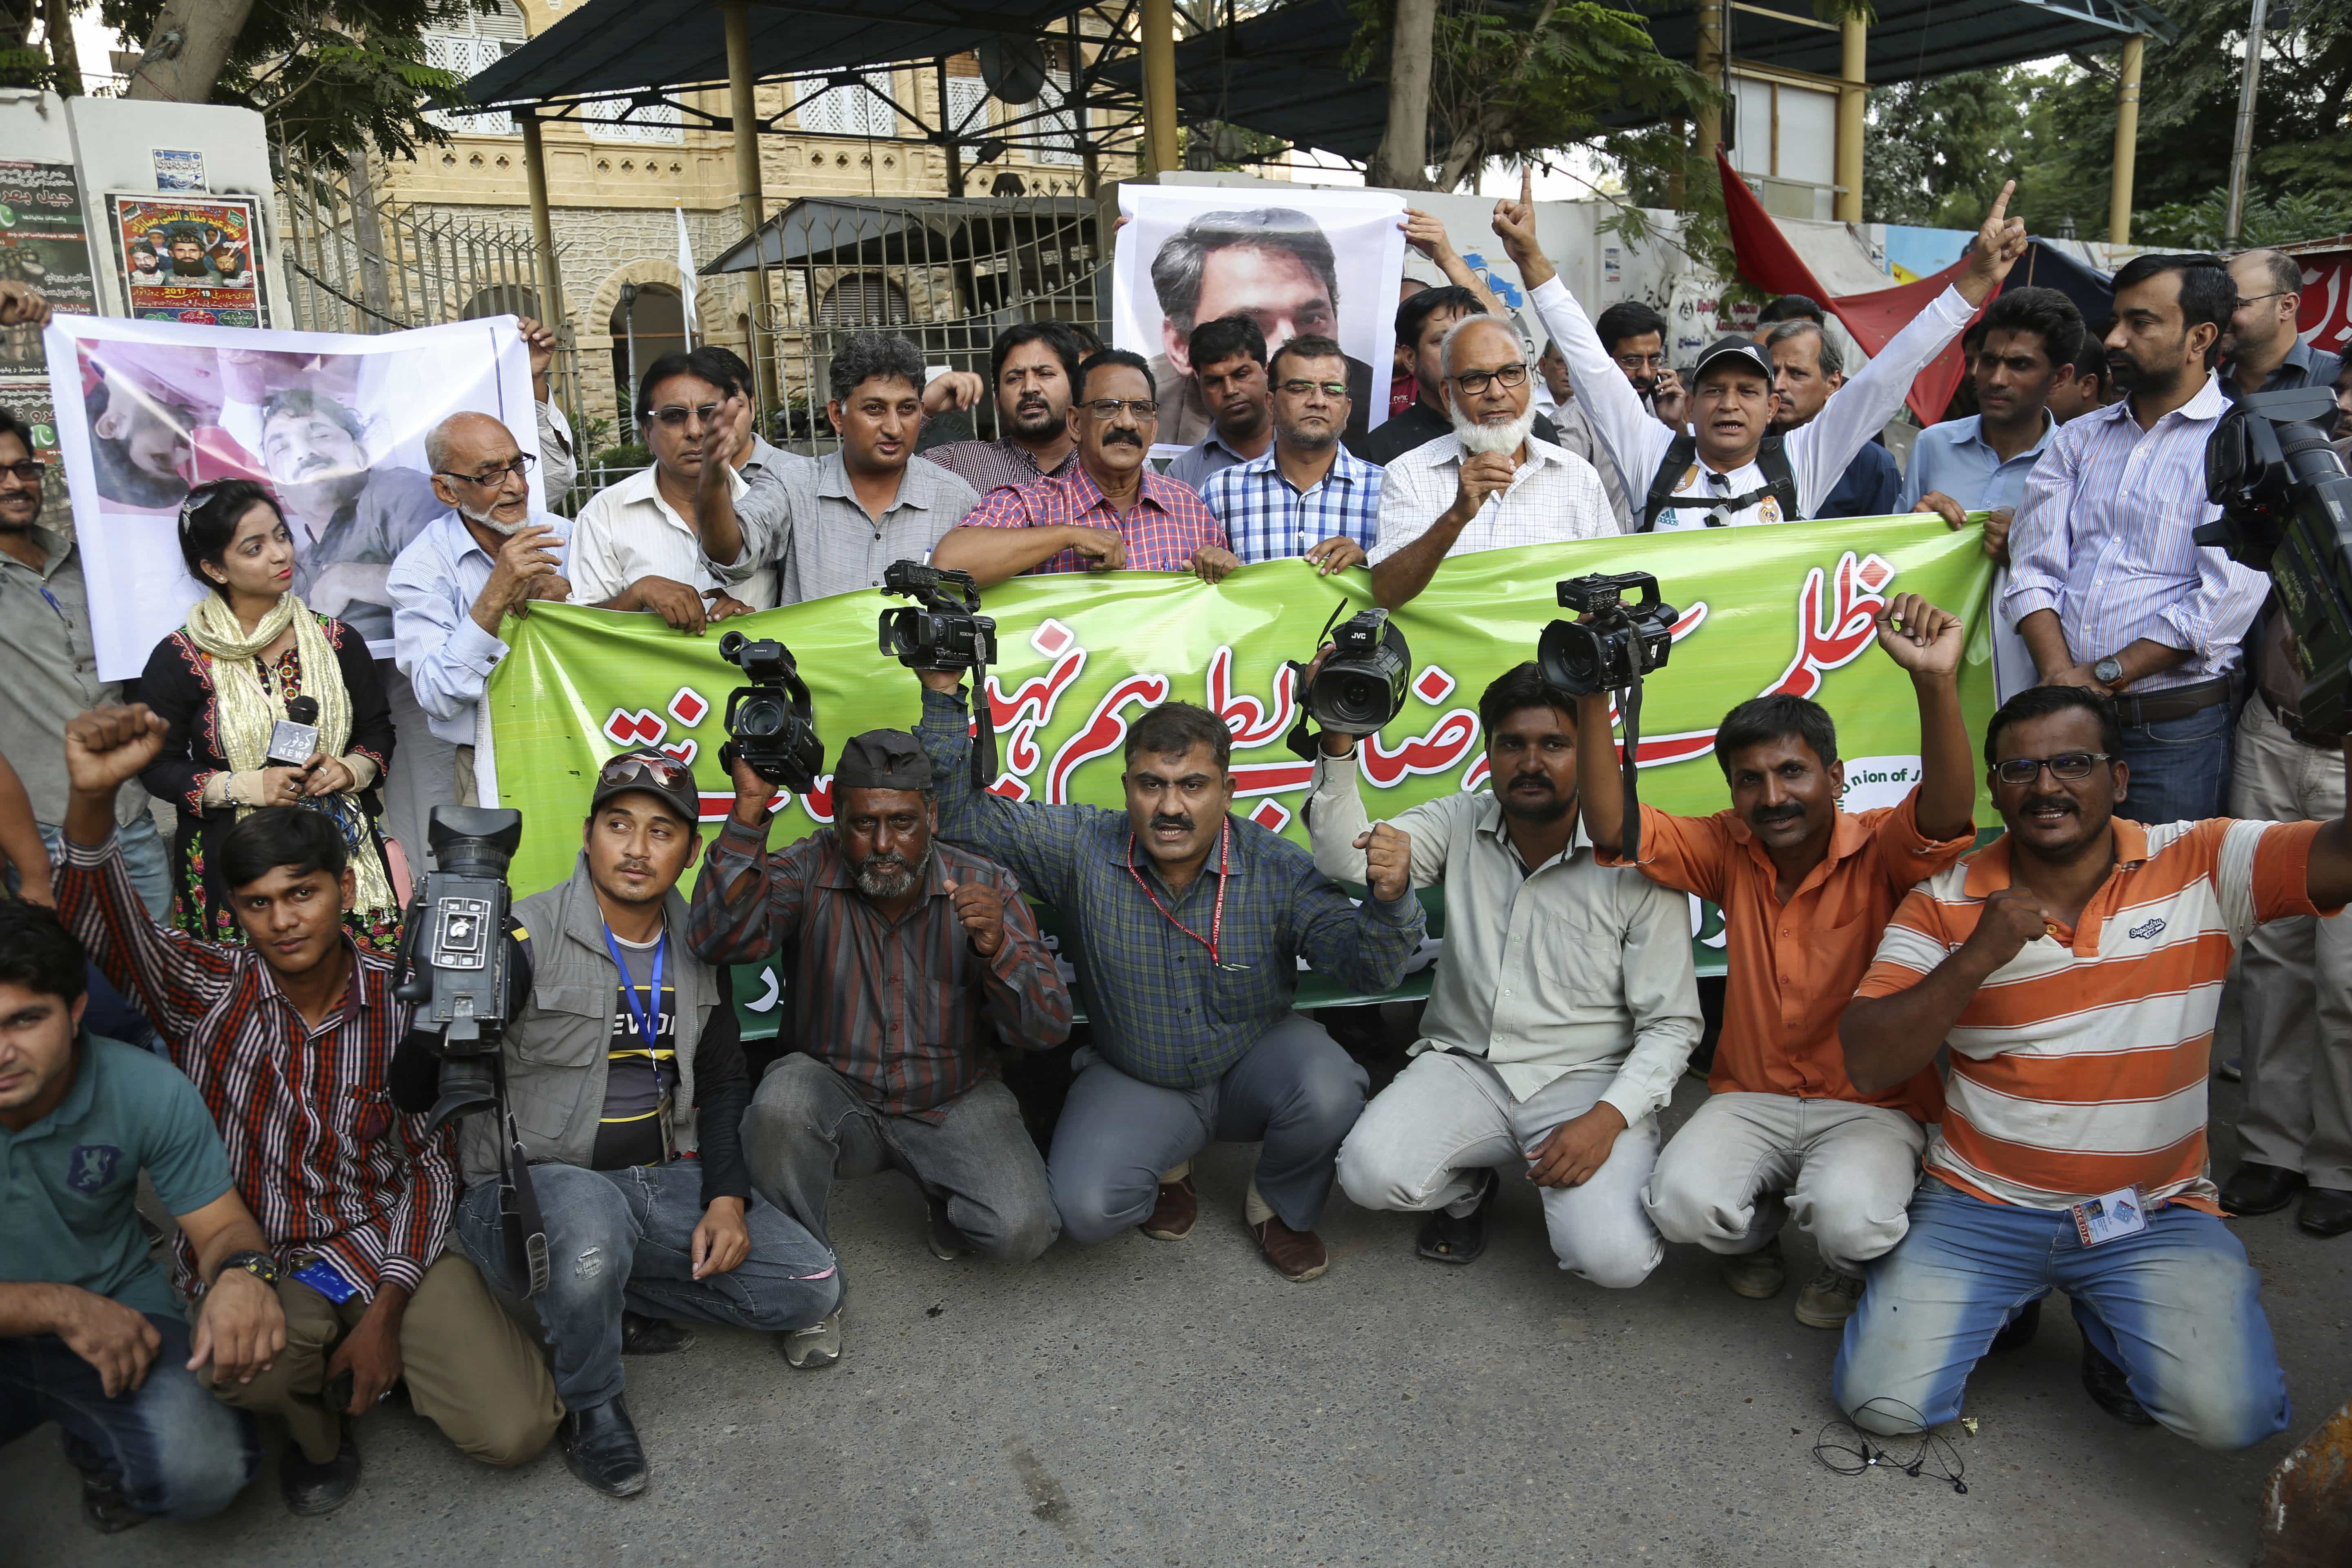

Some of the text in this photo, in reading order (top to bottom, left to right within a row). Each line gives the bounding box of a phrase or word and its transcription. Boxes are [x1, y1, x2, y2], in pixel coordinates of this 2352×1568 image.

[37, 190, 74, 207] جیل
[159, 211, 182, 225] النبی
[184, 212, 207, 224] میلاد
[207, 218, 224, 228] عید
[1657, 517, 1679, 526] adidas
[282, 731, 315, 750] کوہ نور
[1045, 674, 1169, 805] ہم
[278, 747, 311, 760] NEWS
[1891, 768, 1908, 782] of
[1218, 873, 1226, 901] AIRWAVES
[2074, 1207, 2089, 1243] MEDIA
